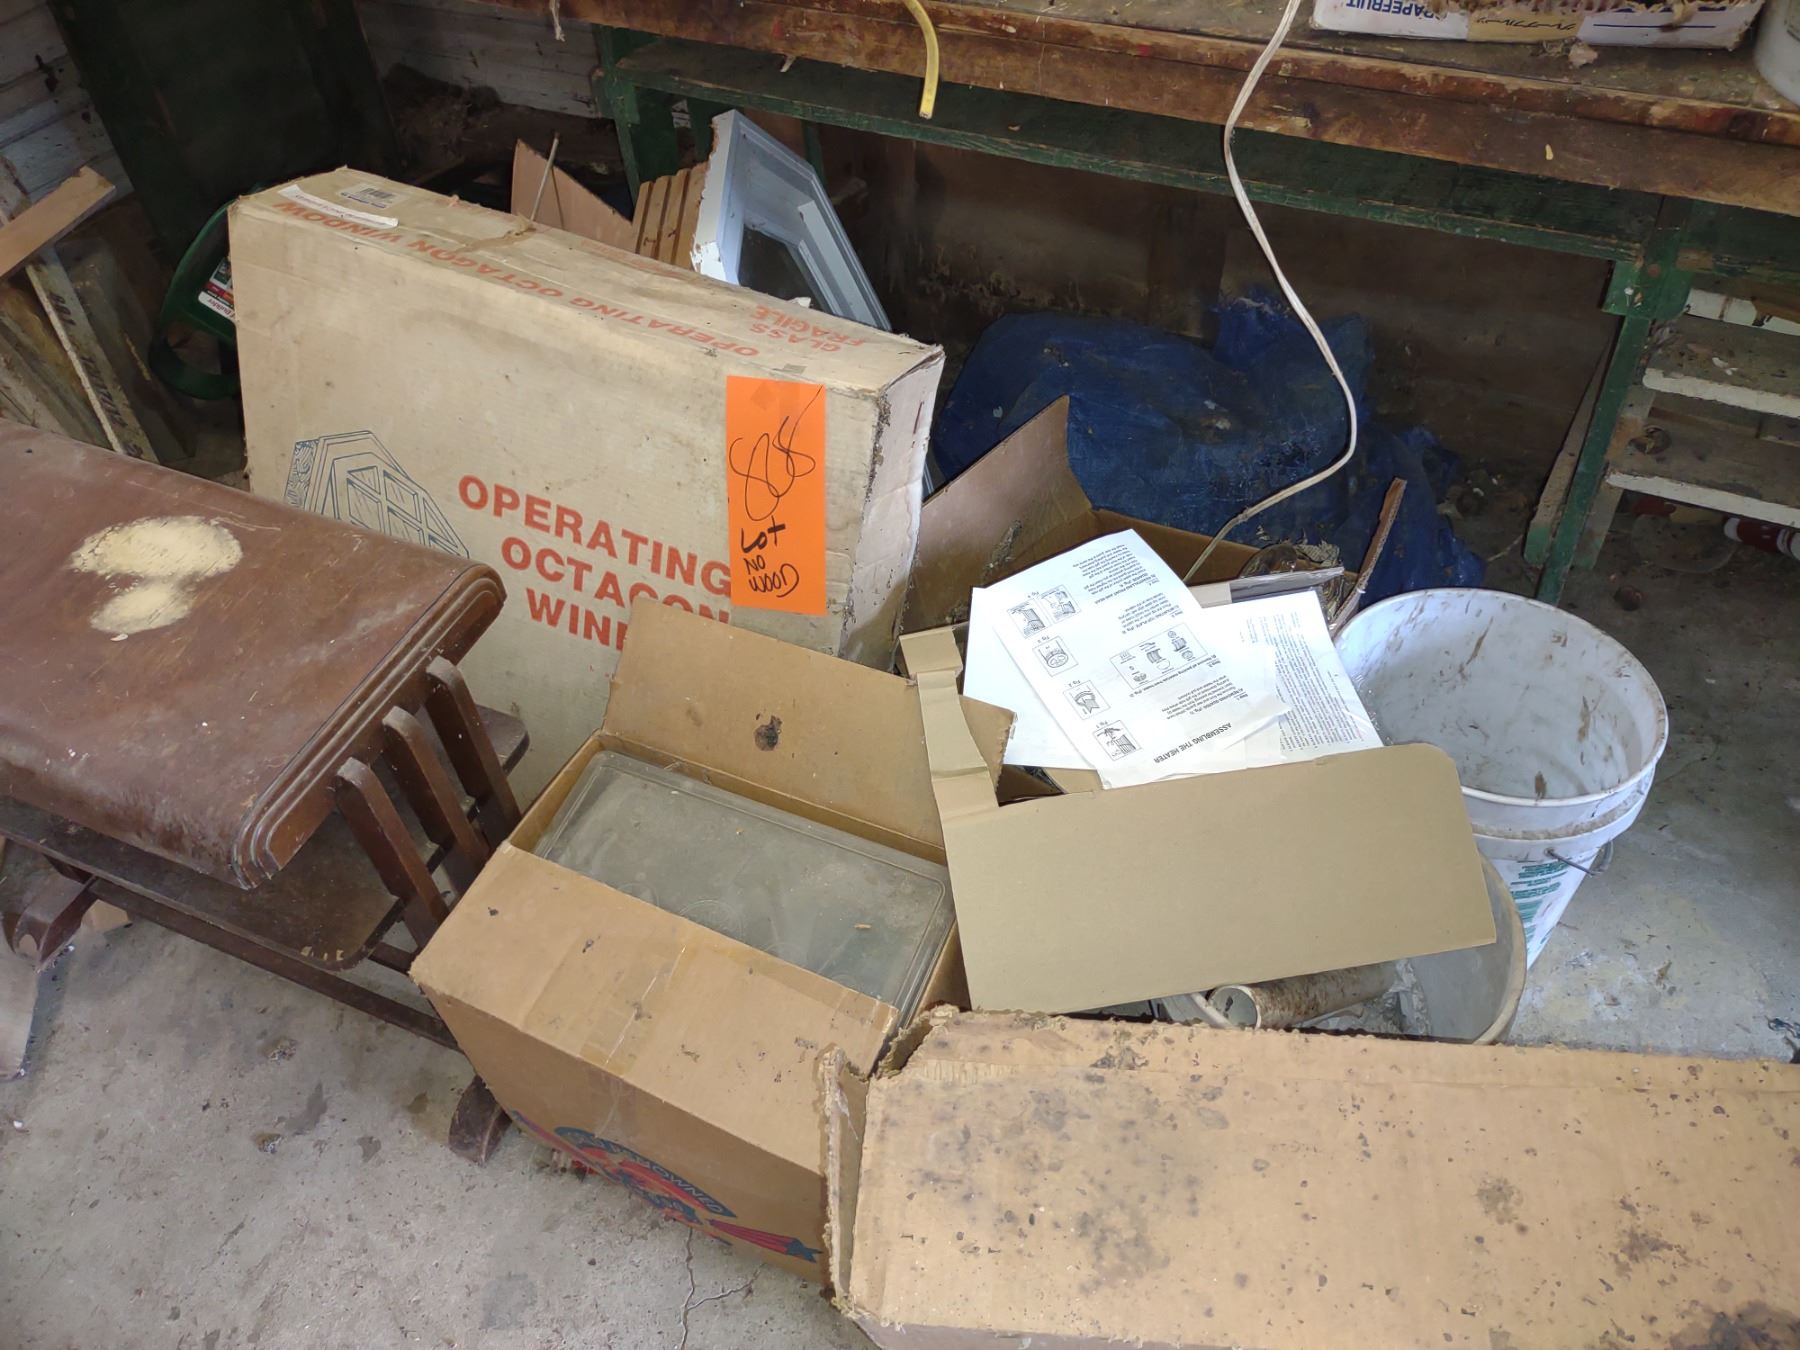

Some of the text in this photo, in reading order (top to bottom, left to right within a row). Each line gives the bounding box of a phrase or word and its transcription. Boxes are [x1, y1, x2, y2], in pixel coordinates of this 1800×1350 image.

[1346, 0, 1447, 20] RAPEFRUIT
[271, 201, 402, 244] WINDOW
[407, 240, 563, 297] OCTAGON
[570, 297, 759, 356] OPERATING
[750, 323, 841, 351] GLASS
[751, 305, 866, 347] FRAGILE
[458, 475, 731, 598] OPERATING
[743, 555, 766, 575] NO
[748, 563, 799, 597] WOOD
[1153, 722, 1232, 763] ASSEMBLING THE HEATER
[652, 1165, 724, 1214] OWNED
